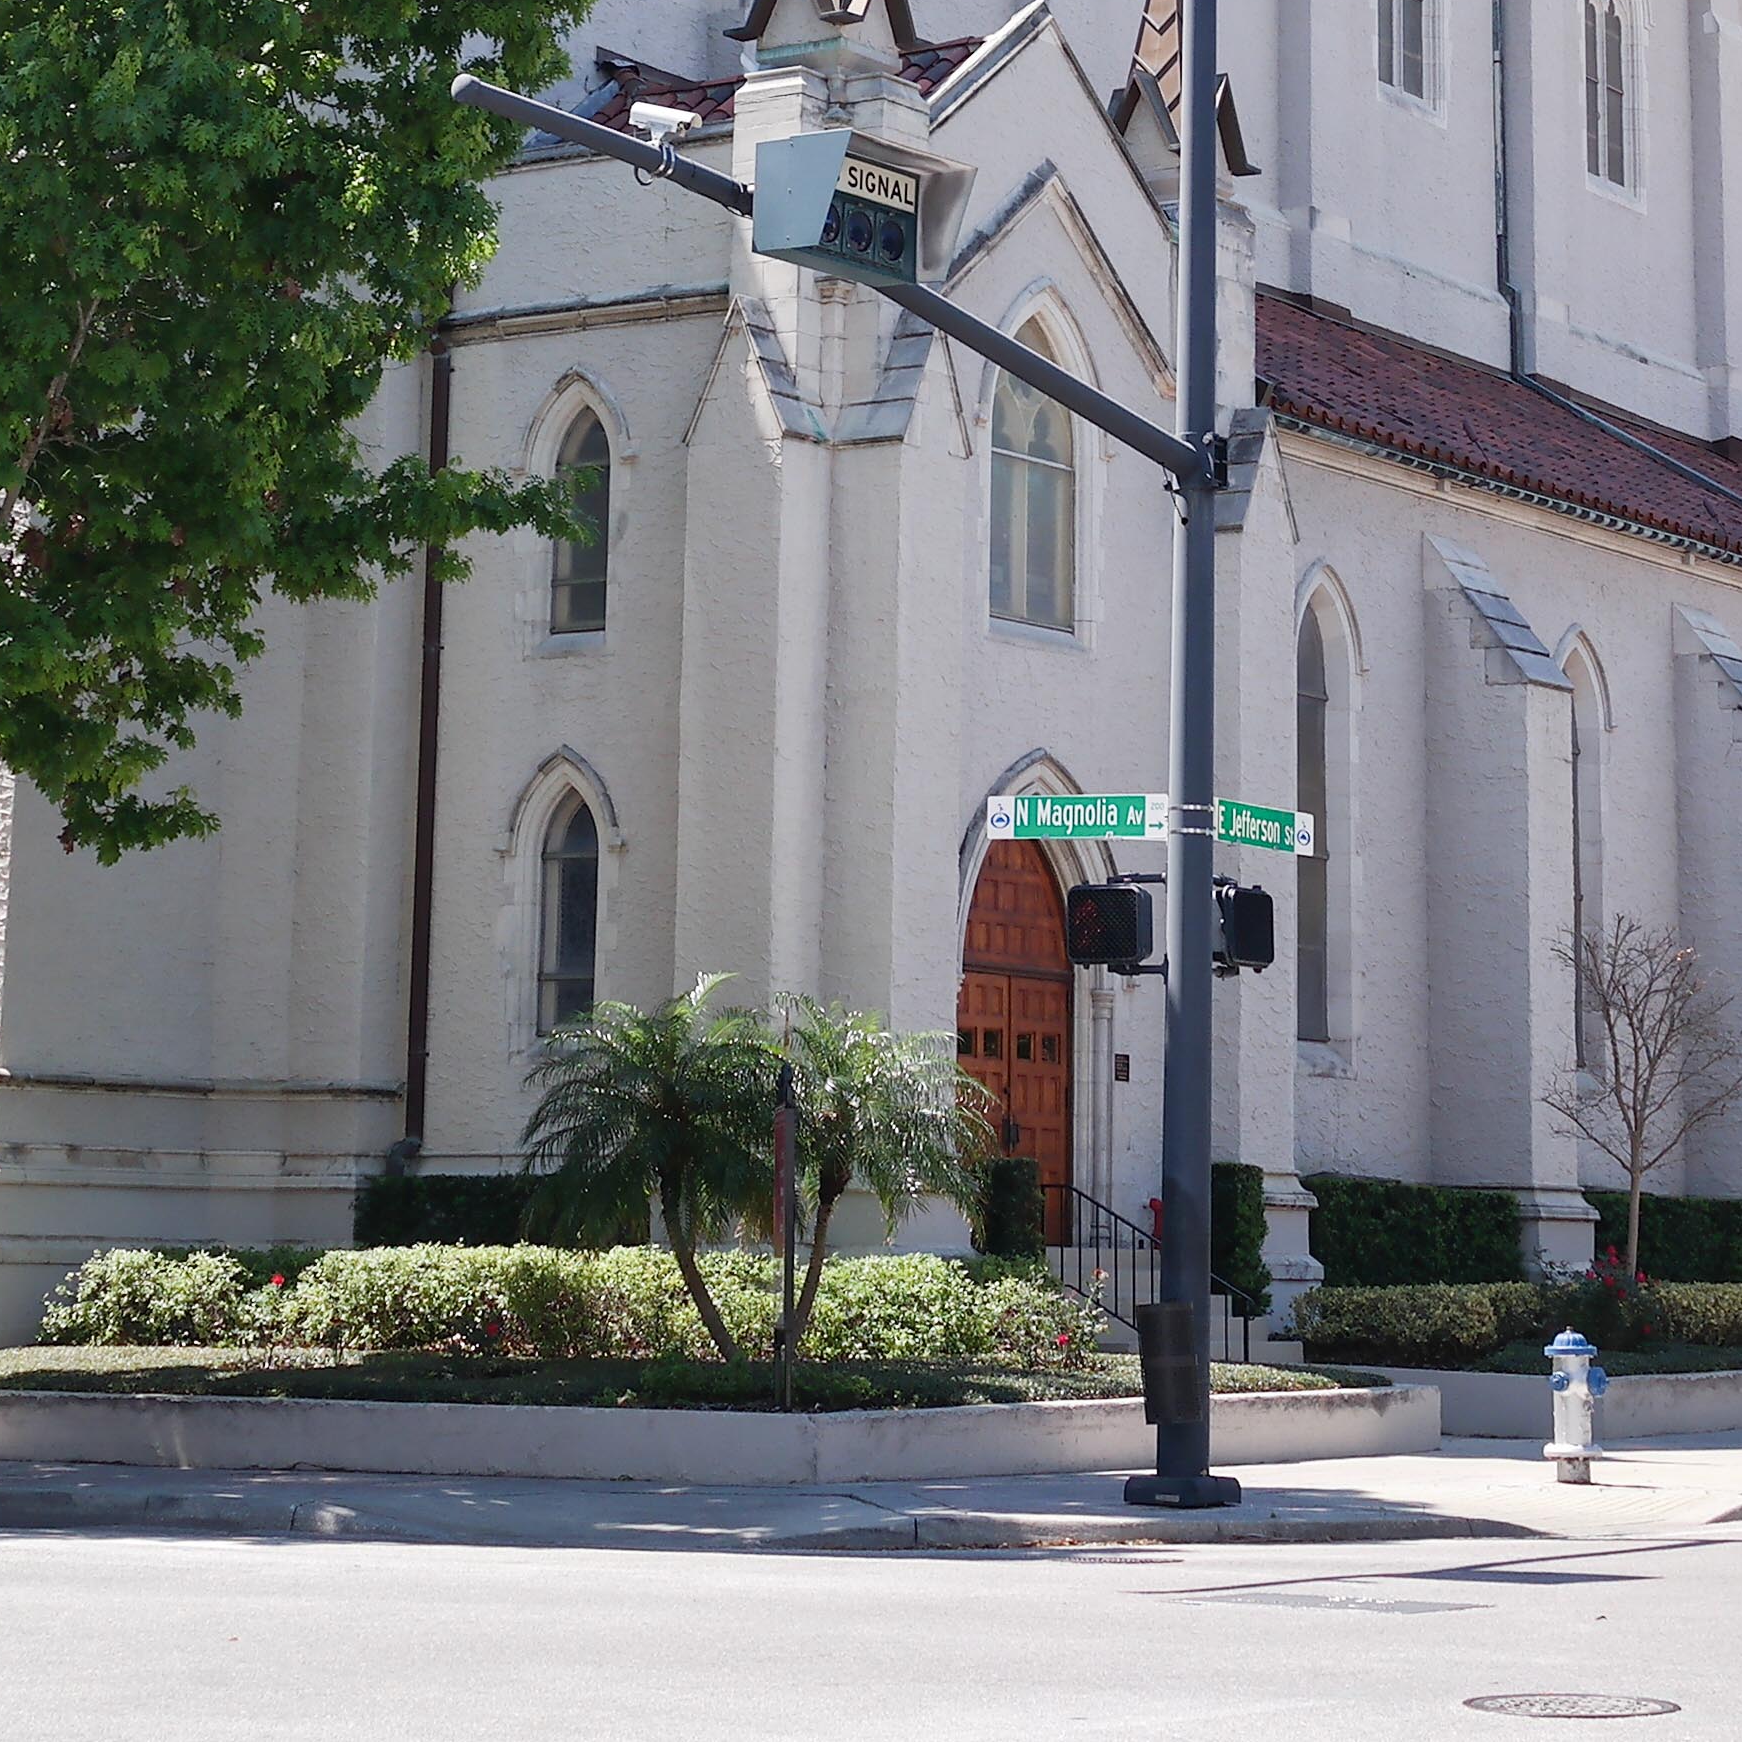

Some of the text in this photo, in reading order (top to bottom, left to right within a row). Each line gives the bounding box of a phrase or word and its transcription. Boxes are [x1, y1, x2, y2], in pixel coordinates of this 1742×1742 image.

[847, 165, 914, 206] SIGNAL
[1016, 797, 1144, 835] N Magnolia Av
[1218, 805, 1226, 835] E
[1228, 807, 1281, 844] Jefferson
